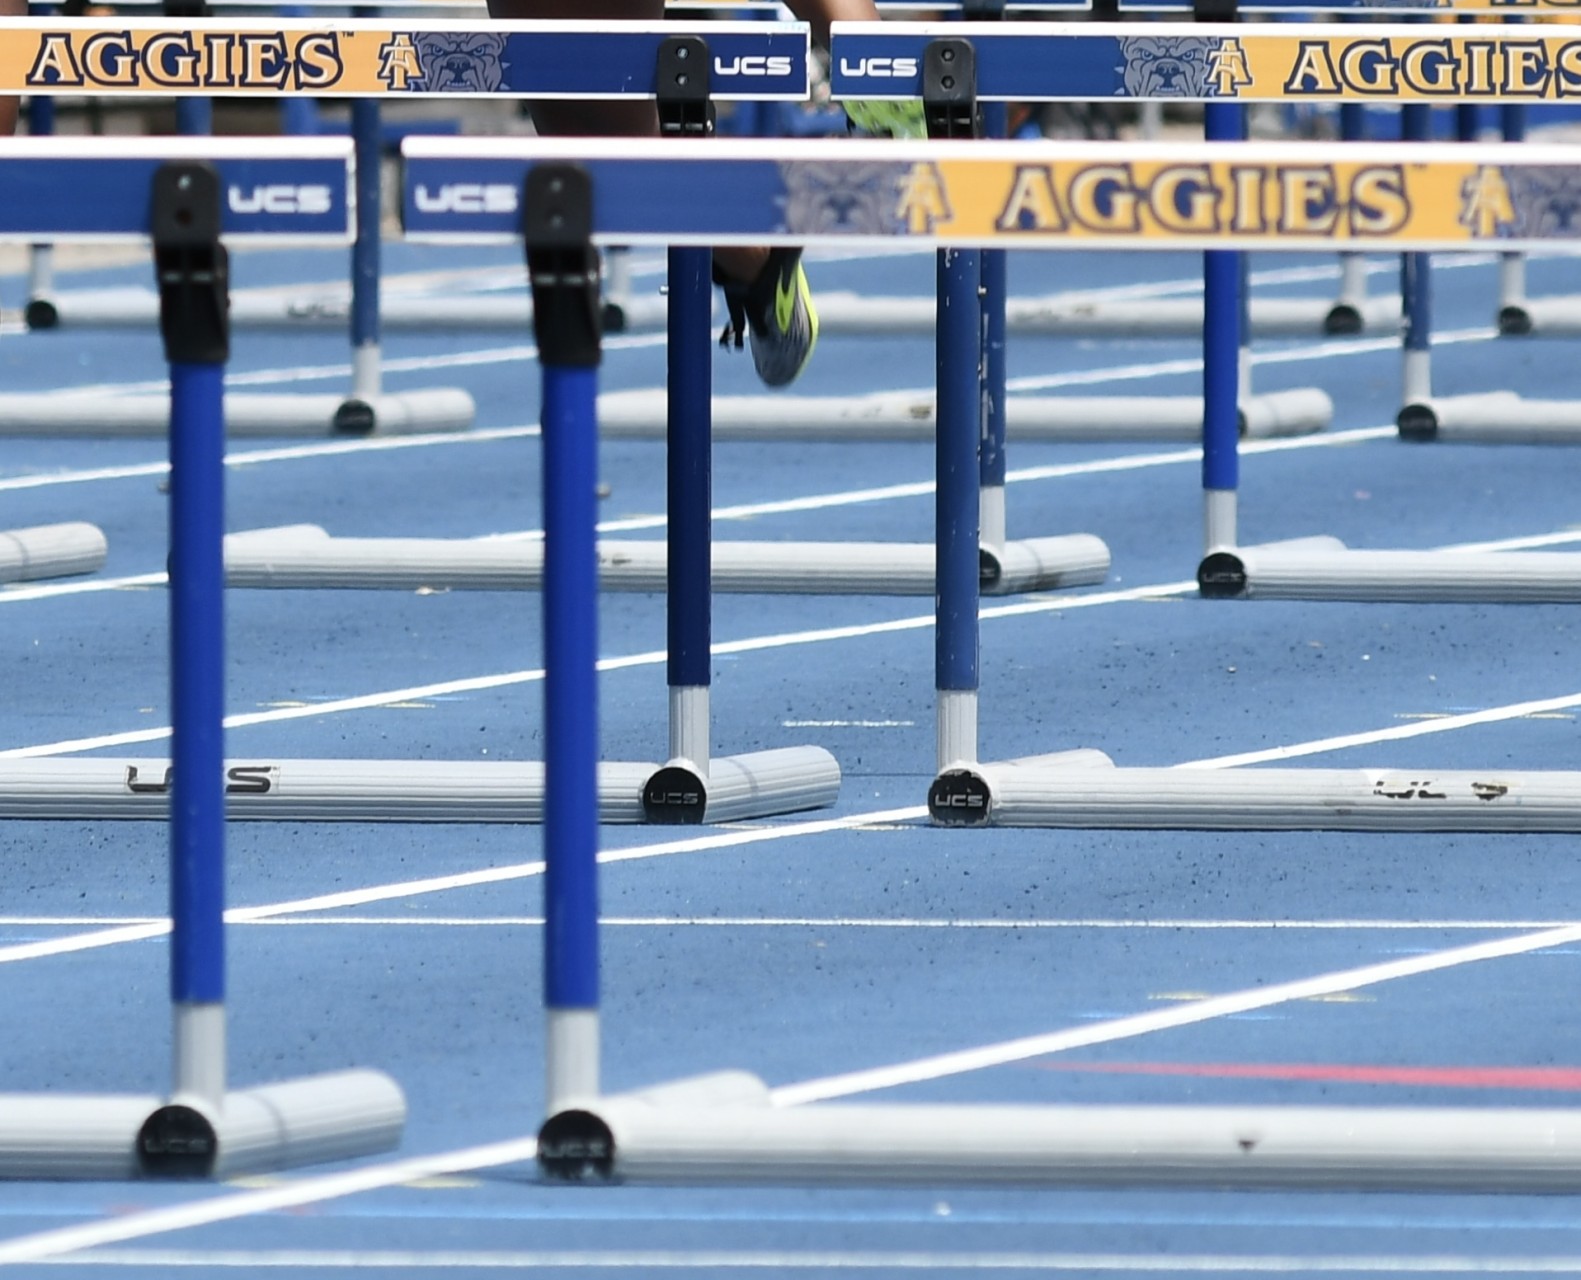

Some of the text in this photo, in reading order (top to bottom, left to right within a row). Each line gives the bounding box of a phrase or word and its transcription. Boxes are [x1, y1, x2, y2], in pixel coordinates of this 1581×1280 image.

[25, 30, 344, 91] AGGIES
[714, 56, 792, 76] UCS
[840, 57, 918, 78] UCS
[228, 184, 332, 213] UCS
[414, 183, 518, 213] UCS
[995, 162, 1412, 238] AGGIES
[127, 765, 272, 794] US
[649, 791, 699, 805] UCS
[934, 793, 983, 808] UCS
